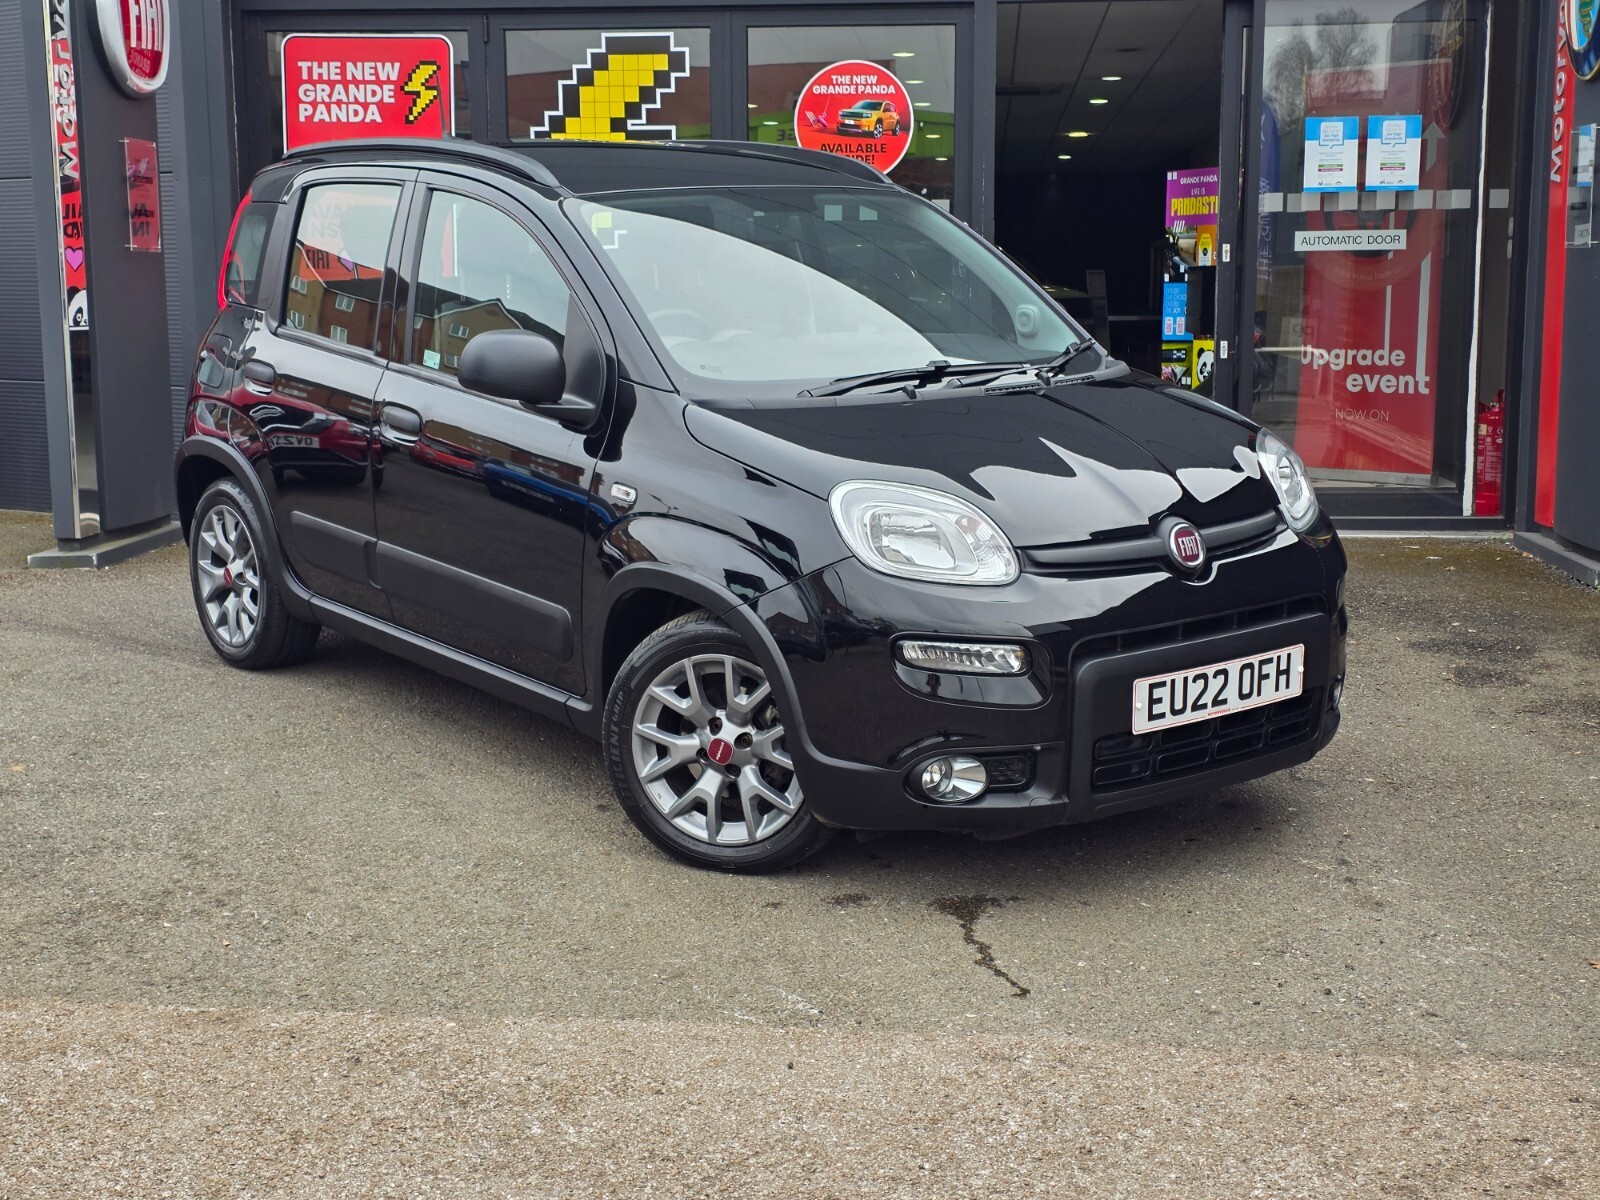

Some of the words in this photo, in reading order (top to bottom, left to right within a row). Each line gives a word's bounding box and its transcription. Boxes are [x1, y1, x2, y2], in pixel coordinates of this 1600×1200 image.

[298, 61, 341, 80] THE
[347, 62, 400, 81] NEW
[831, 75, 851, 84] THE
[853, 75, 877, 84] NEW
[298, 84, 395, 103] GRANDE
[812, 85, 856, 94] GRANDE
[858, 85, 896, 94] PANDA
[299, 104, 382, 123] PANDA
[820, 143, 887, 153] AVAILABLE
[1180, 176, 1200, 185] GRANDE
[1200, 174, 1218, 183] PANDA
[1301, 235, 1362, 246] AUTOMATIC
[1367, 235, 1401, 245] DOOR
[1300, 344, 1405, 371] Upgrade
[1346, 373, 1430, 394] event
[1335, 408, 1367, 420] NOW
[1369, 409, 1390, 422] ON
[1178, 535, 1199, 557] FIAT
[1148, 667, 1229, 723] EU22
[1237, 652, 1292, 702] OFH
